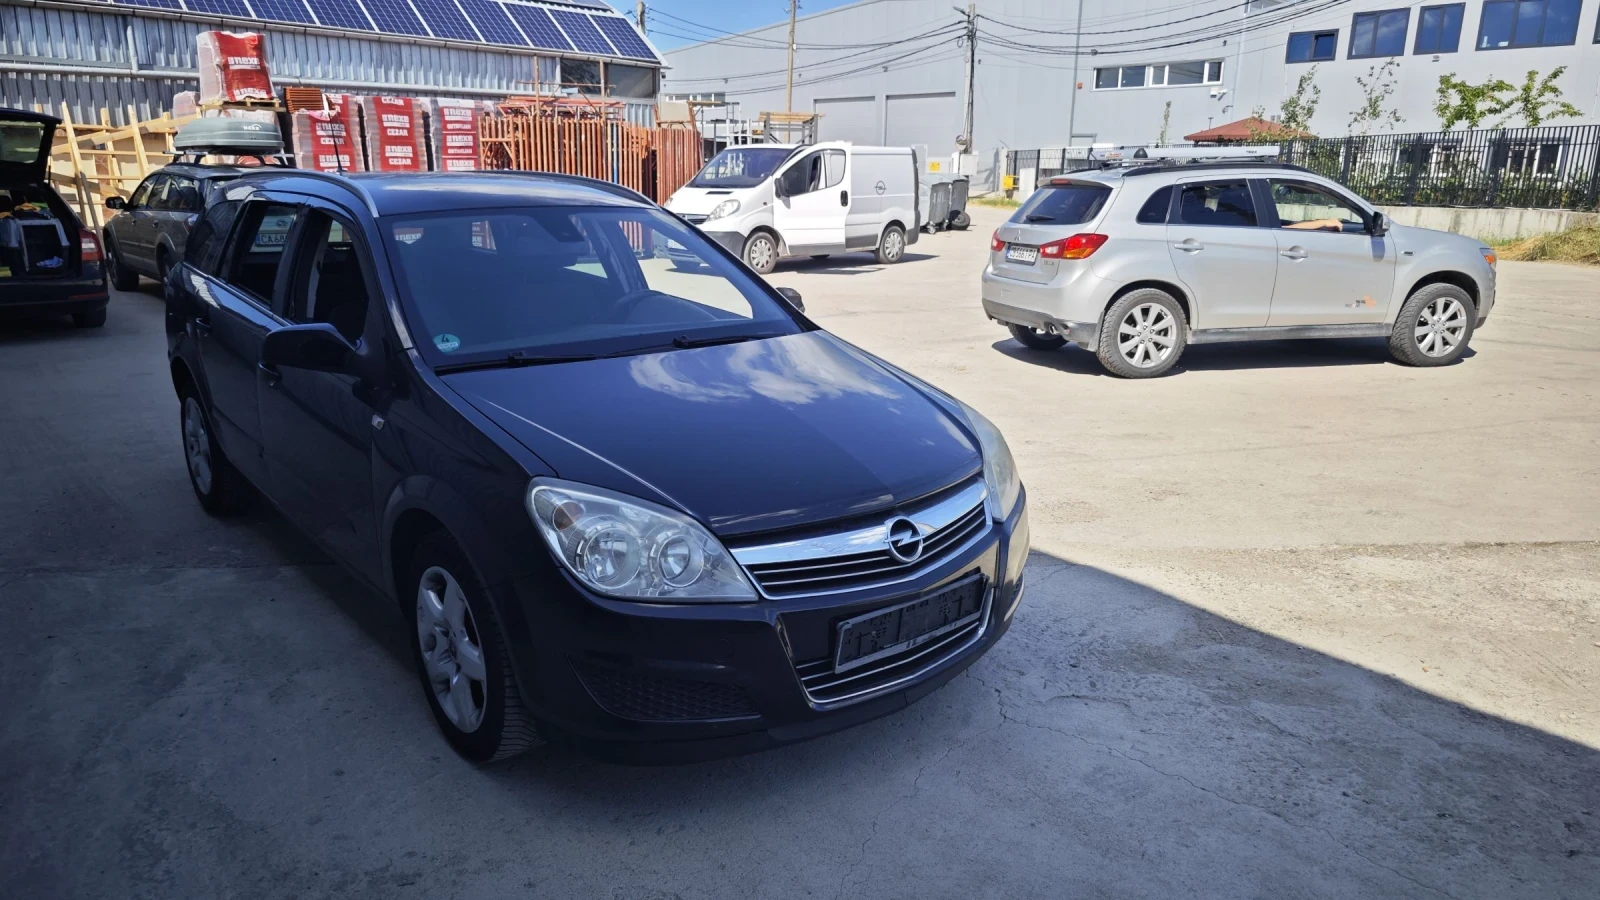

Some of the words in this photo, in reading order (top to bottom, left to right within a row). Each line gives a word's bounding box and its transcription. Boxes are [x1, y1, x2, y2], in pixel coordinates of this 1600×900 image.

[233, 57, 260, 65] nexe
[386, 128, 409, 136] CEZAR
[441, 334, 450, 343] 4
